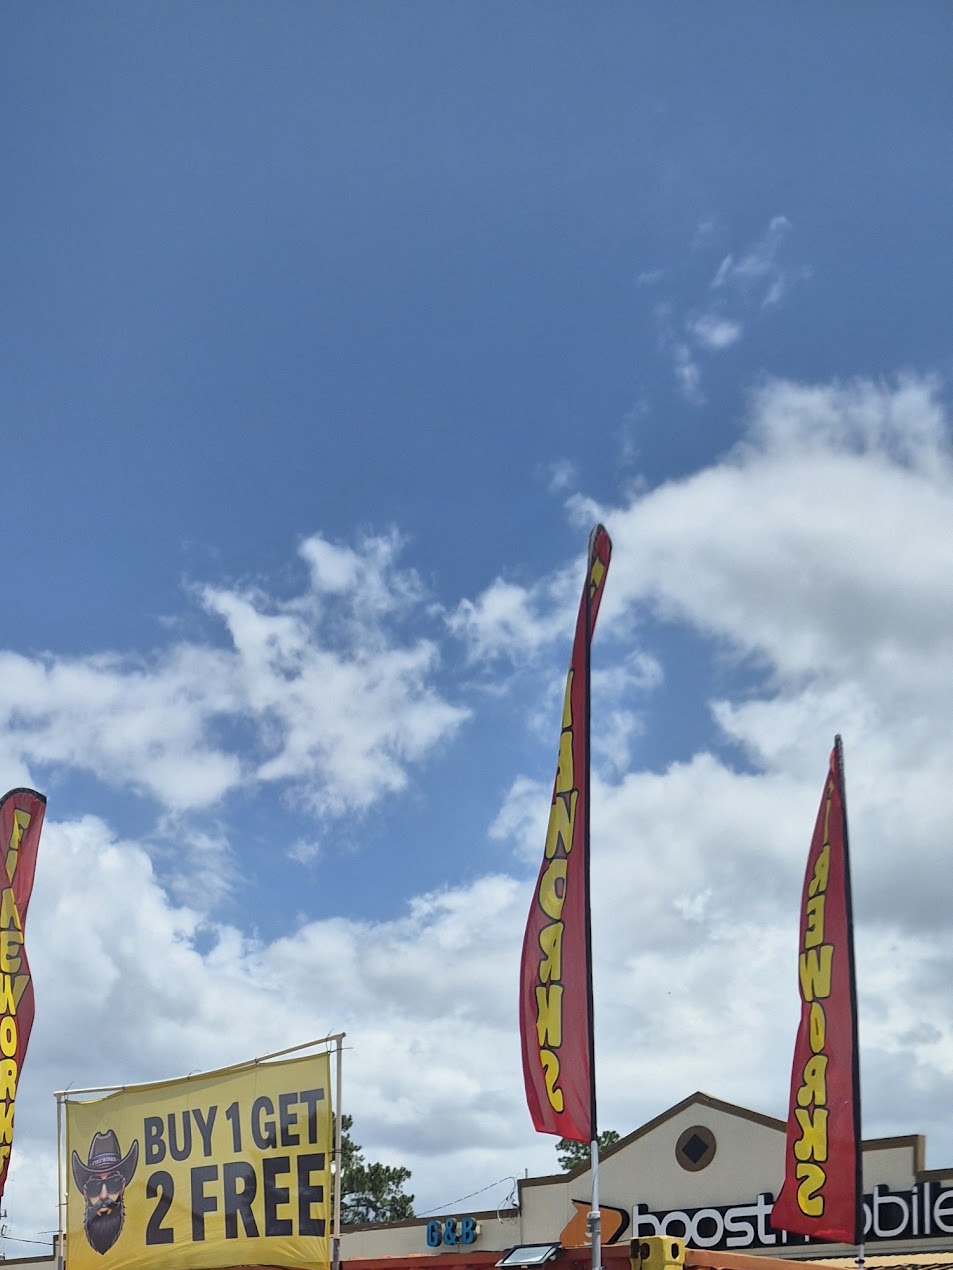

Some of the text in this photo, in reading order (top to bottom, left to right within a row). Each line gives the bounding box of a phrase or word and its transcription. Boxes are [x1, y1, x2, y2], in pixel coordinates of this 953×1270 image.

[143, 1088, 325, 1165] BUY 1 GET
[145, 1152, 326, 1246] 2 FREE
[632, 1192, 775, 1248] boost
